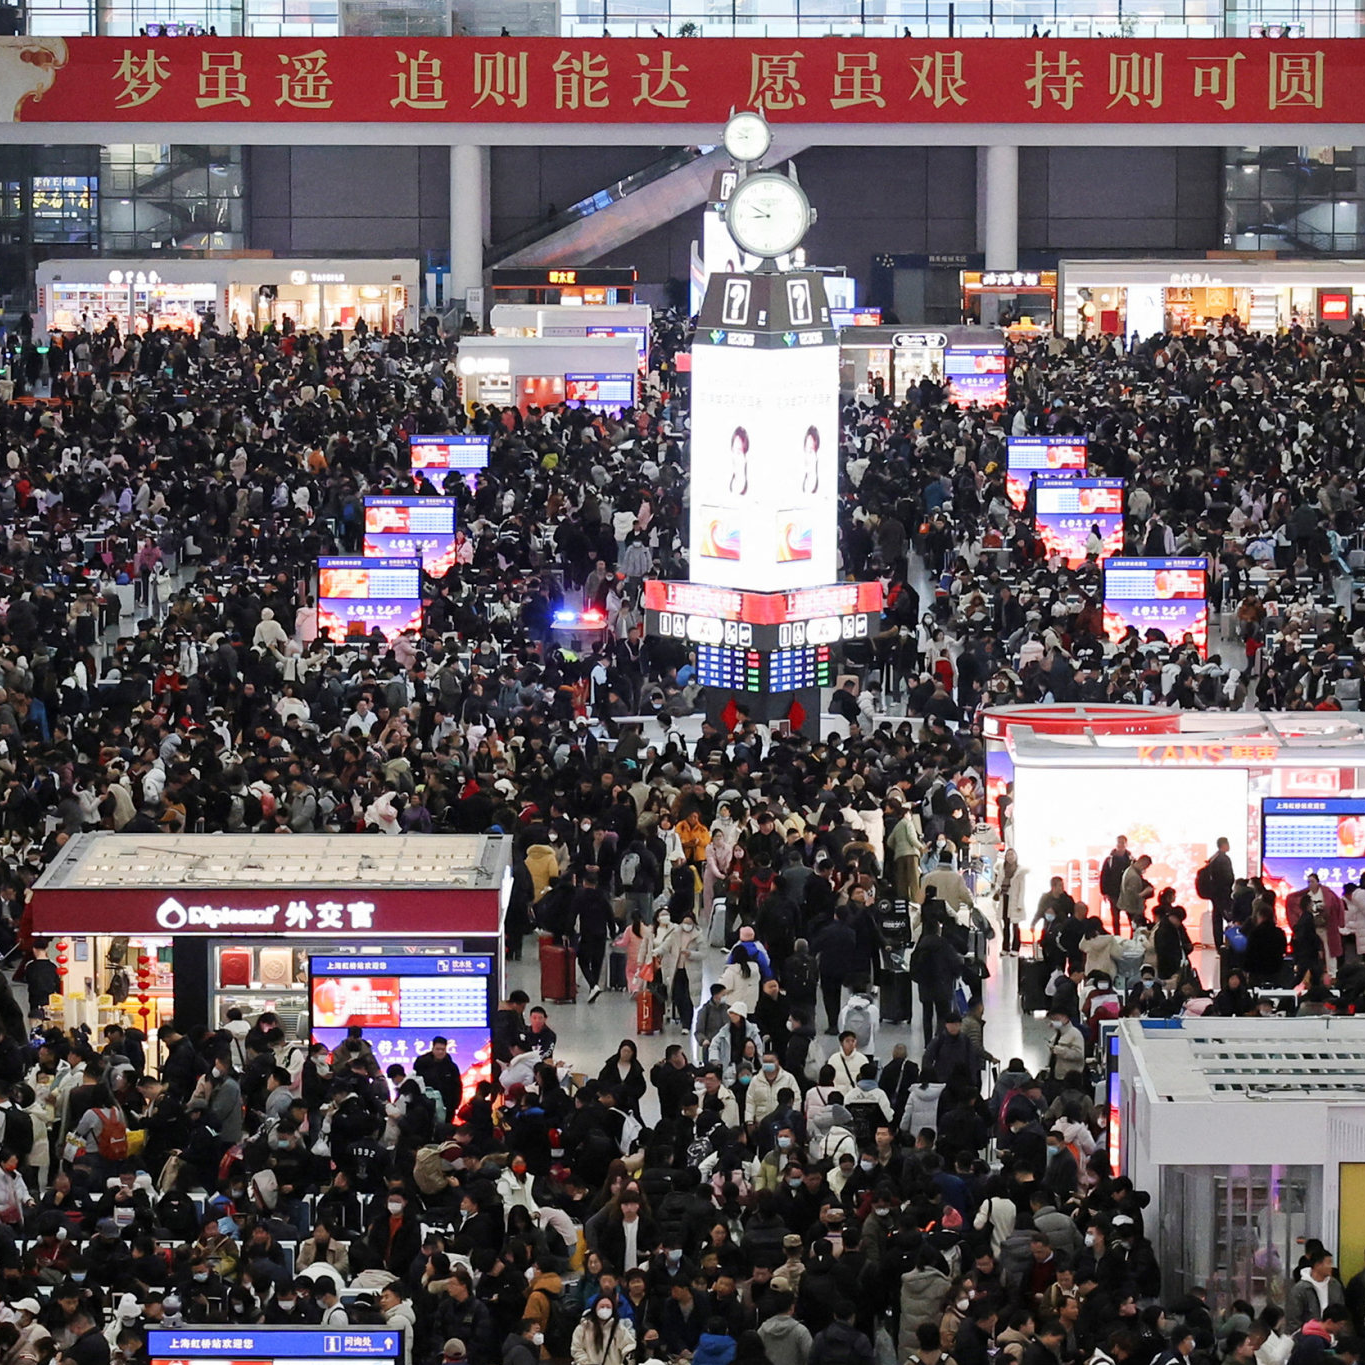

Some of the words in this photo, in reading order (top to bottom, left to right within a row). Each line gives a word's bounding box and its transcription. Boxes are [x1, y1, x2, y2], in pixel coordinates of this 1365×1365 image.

[112, 50, 335, 109] 梦虽遥
[390, 50, 691, 109] 追则能达
[746, 51, 968, 110] 愿虽艰
[1024, 51, 1326, 110] 持则可圆
[1138, 746, 1225, 764] KANS
[285, 901, 376, 929] 外交官
[169, 1338, 254, 1350] 上海虹桥站欢迎您
[344, 1336, 372, 1347] 问询处
